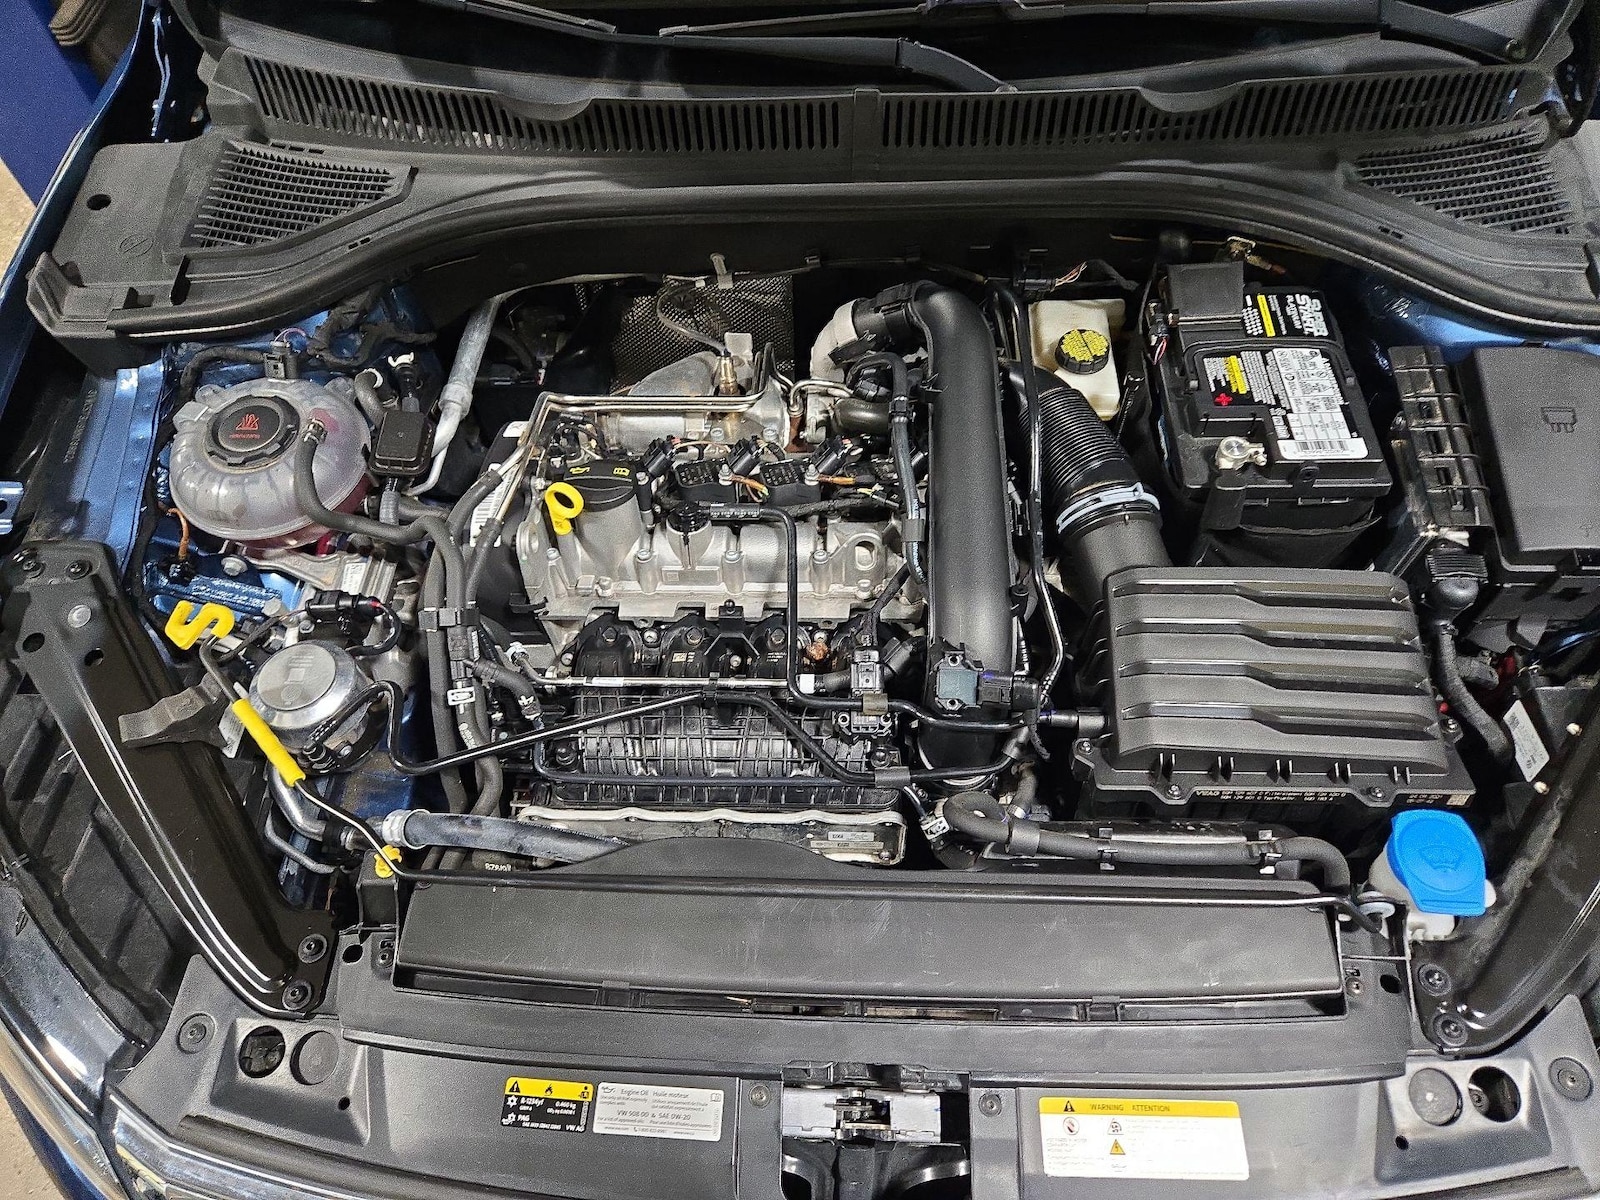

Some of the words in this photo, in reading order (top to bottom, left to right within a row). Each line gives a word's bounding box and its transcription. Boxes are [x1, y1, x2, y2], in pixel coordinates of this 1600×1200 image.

[620, 1088, 639, 1096] Engine
[1090, 1103, 1124, 1112] WARNING
[1132, 1104, 1171, 1112] ATTENTION
